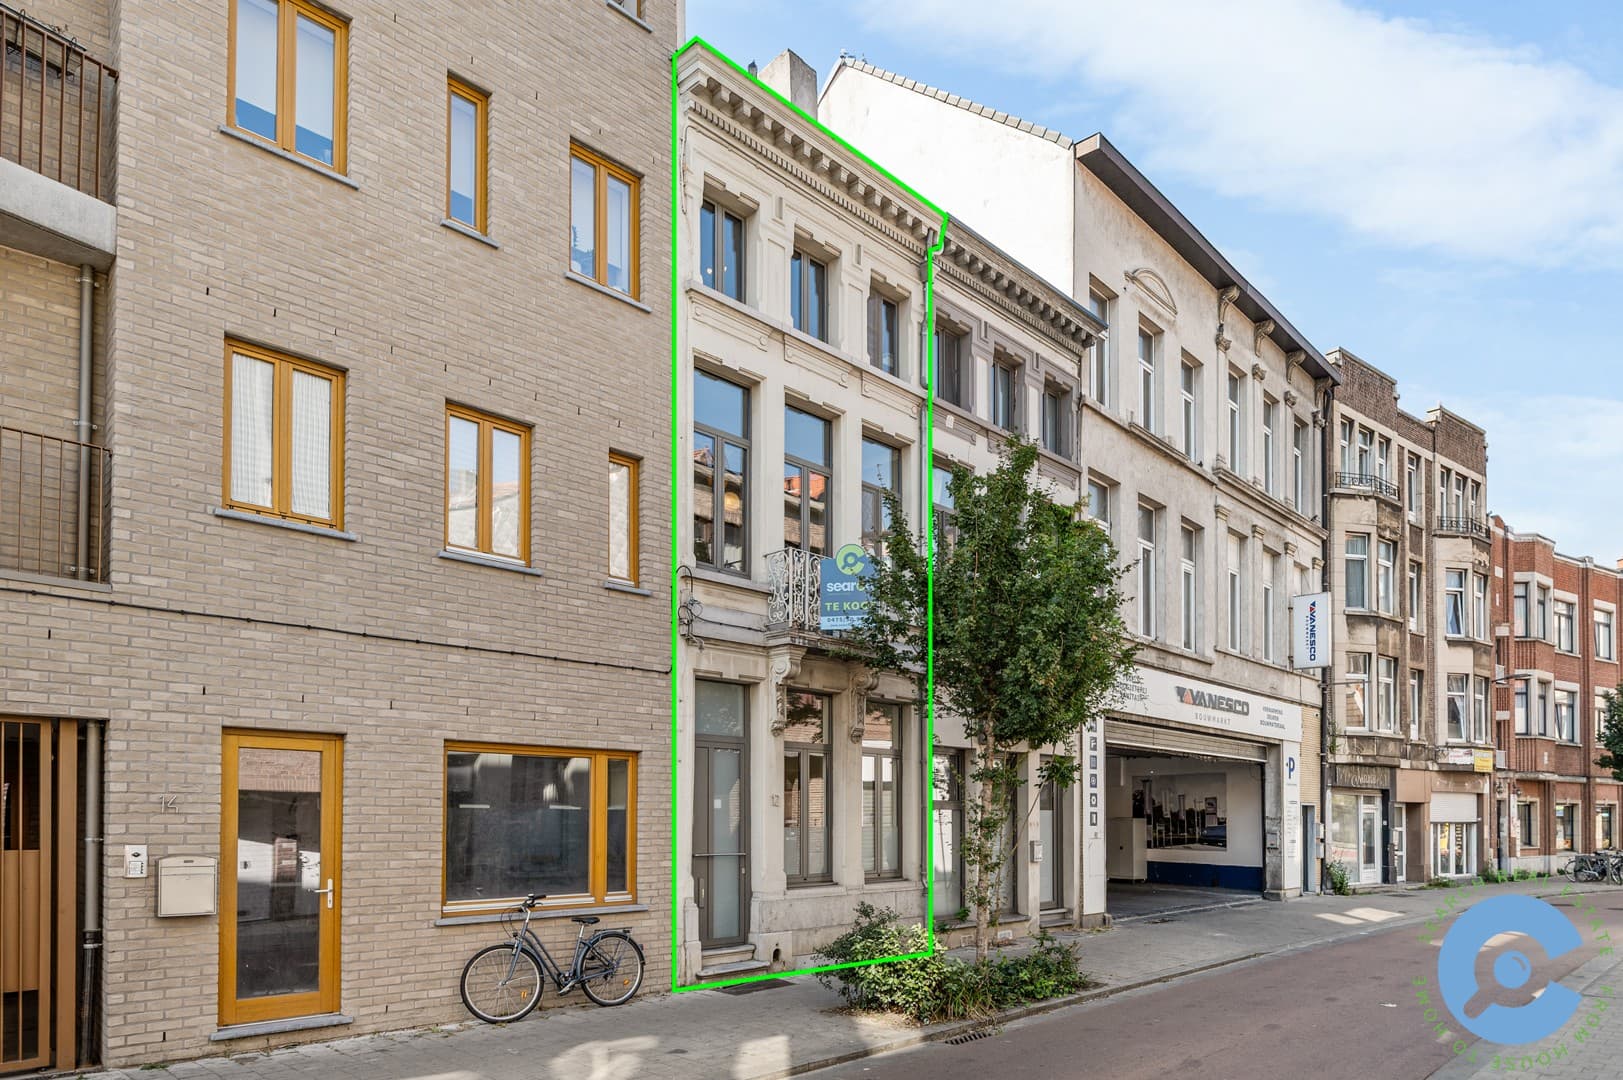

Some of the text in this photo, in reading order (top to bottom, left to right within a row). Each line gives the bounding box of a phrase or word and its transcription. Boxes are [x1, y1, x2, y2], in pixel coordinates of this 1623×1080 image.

[825, 602, 840, 611] TE
[1190, 689, 1250, 716] VANESCO
[1288, 756, 1295, 780] P
[160, 794, 179, 814] 14
